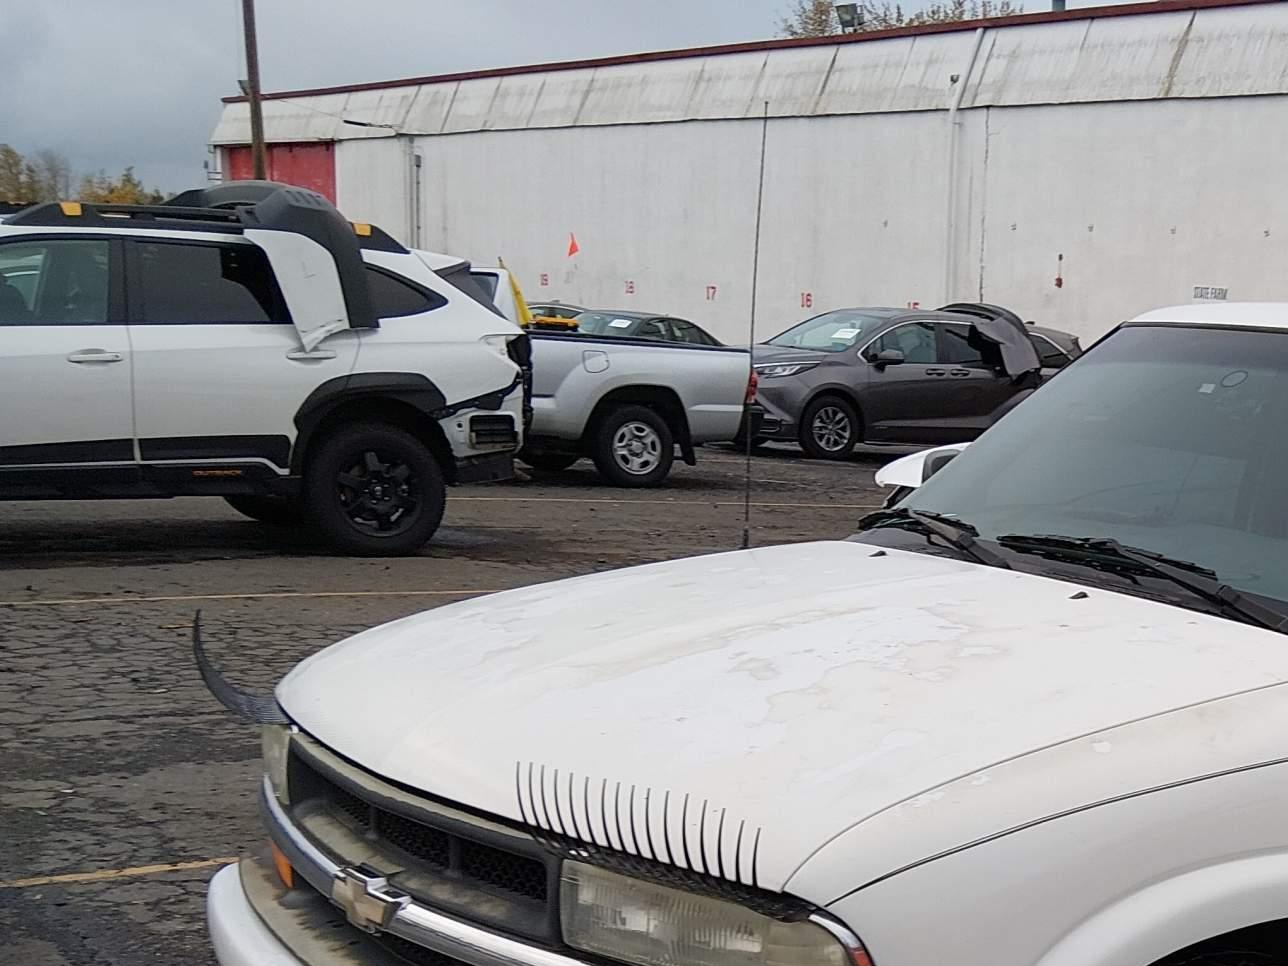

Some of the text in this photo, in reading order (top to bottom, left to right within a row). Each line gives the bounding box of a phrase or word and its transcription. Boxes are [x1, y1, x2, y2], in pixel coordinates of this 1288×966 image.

[706, 286, 717, 300] 17
[800, 292, 812, 308] 16
[1210, 287, 1228, 300] FARM
